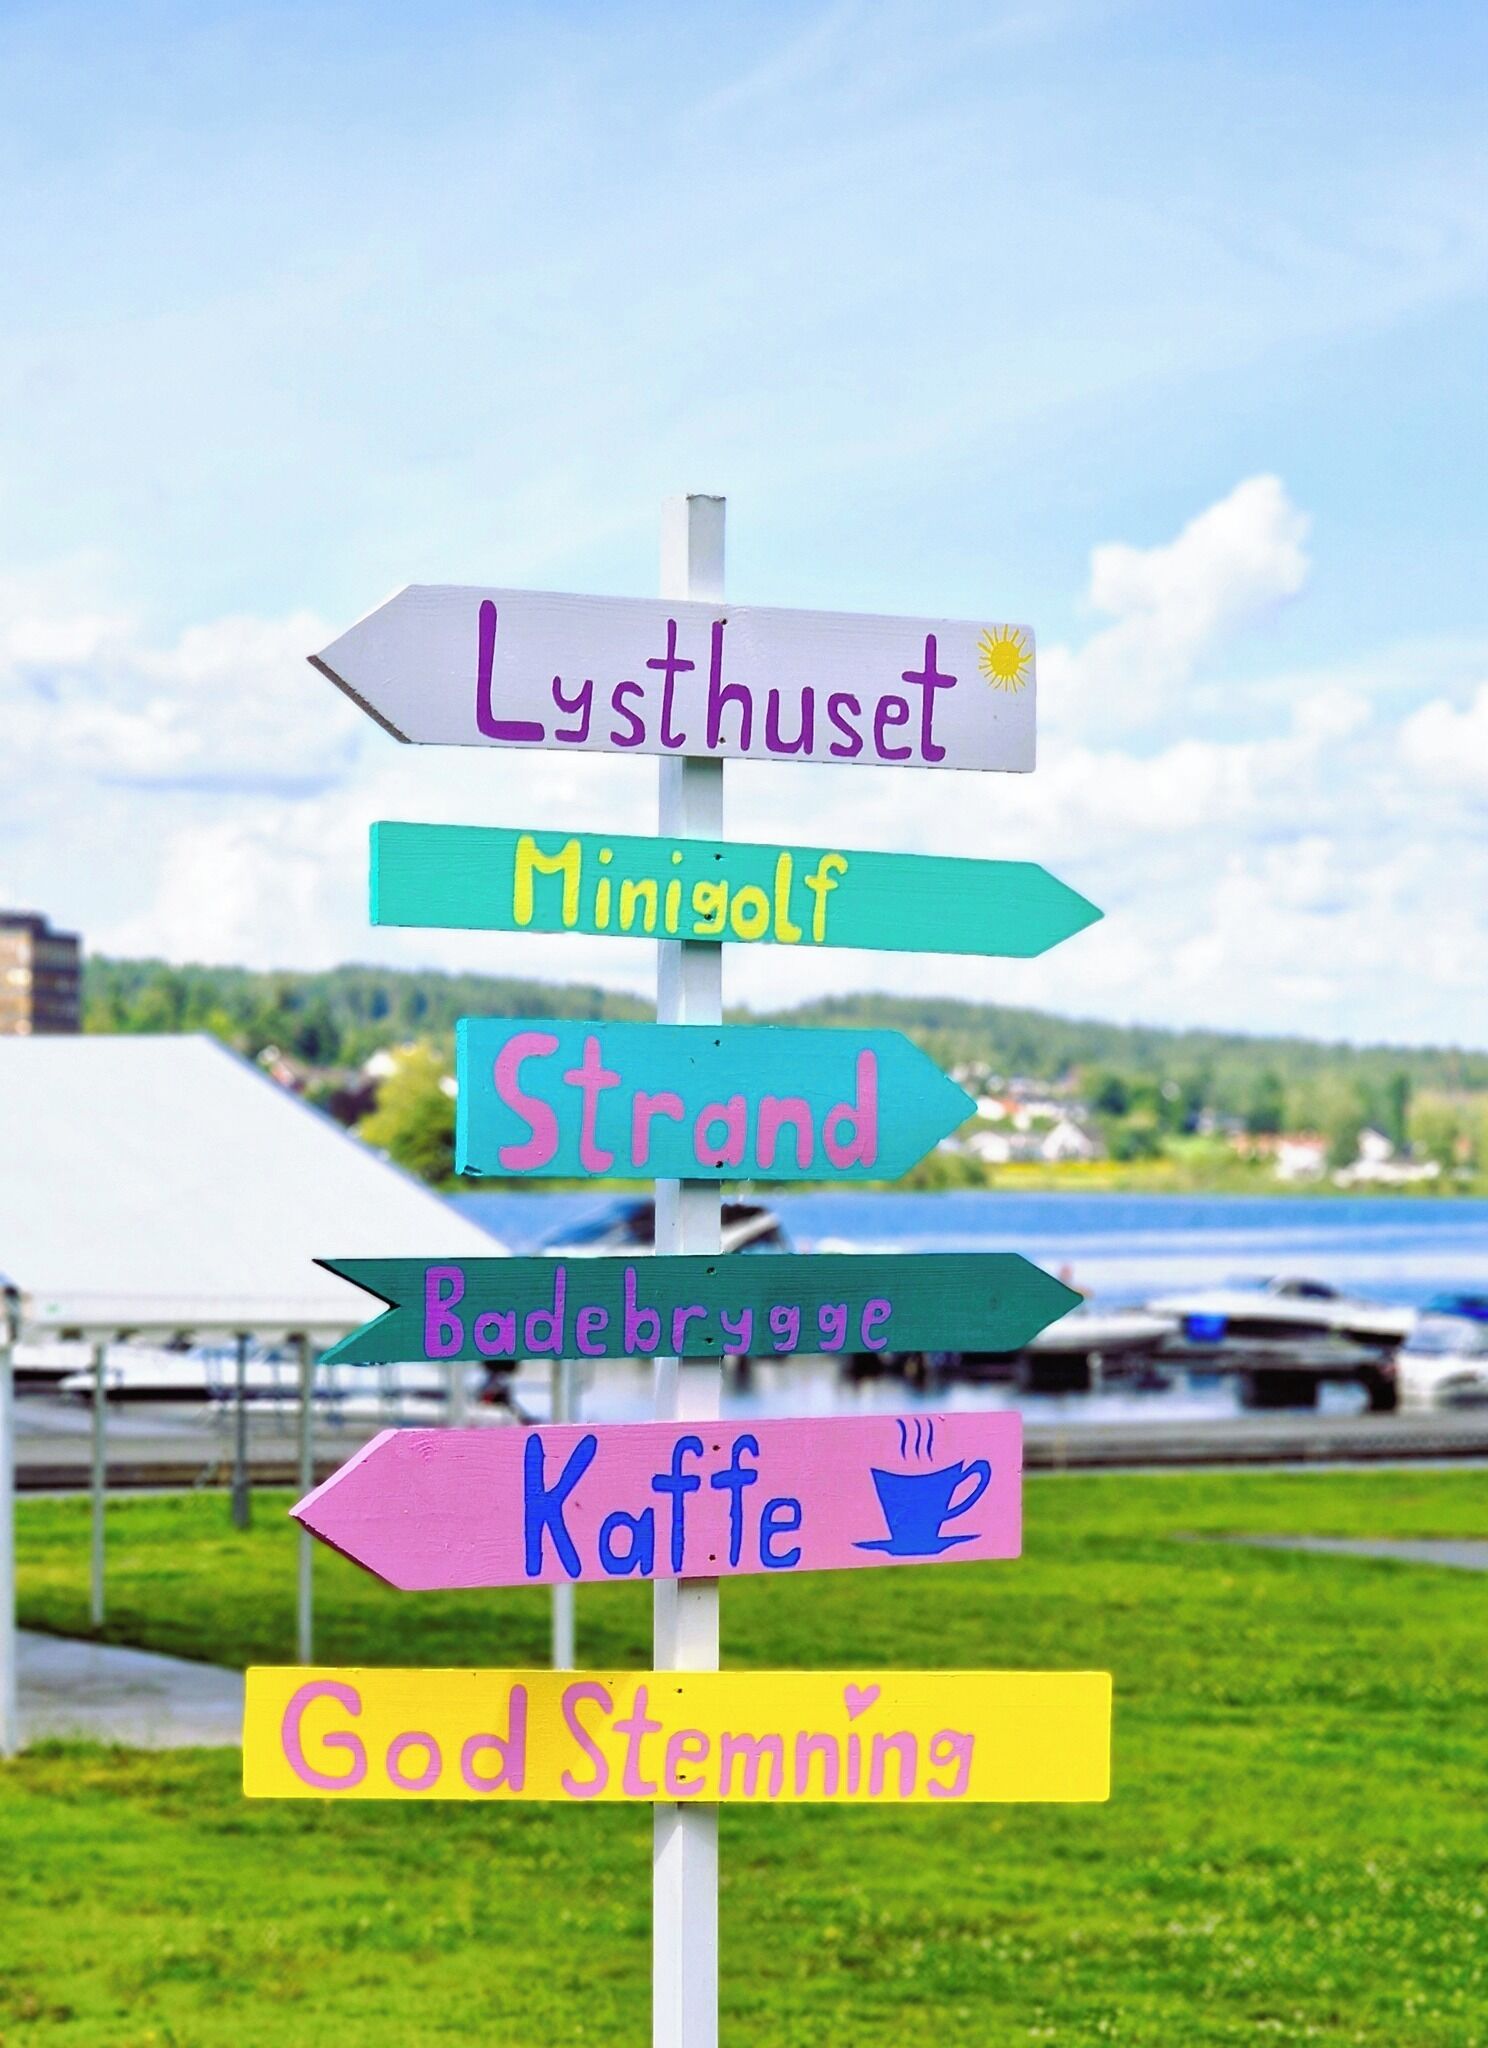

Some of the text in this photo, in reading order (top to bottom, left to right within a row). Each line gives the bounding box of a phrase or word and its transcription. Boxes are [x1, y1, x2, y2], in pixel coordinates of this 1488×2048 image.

[476, 600, 958, 763] Lysthuset
[512, 834, 849, 945] Minigolf
[493, 1032, 878, 1174] Strand
[424, 1265, 893, 1359] Badebrygge
[523, 1432, 803, 1580] Kaffe
[280, 1680, 976, 1799] God Stemning
